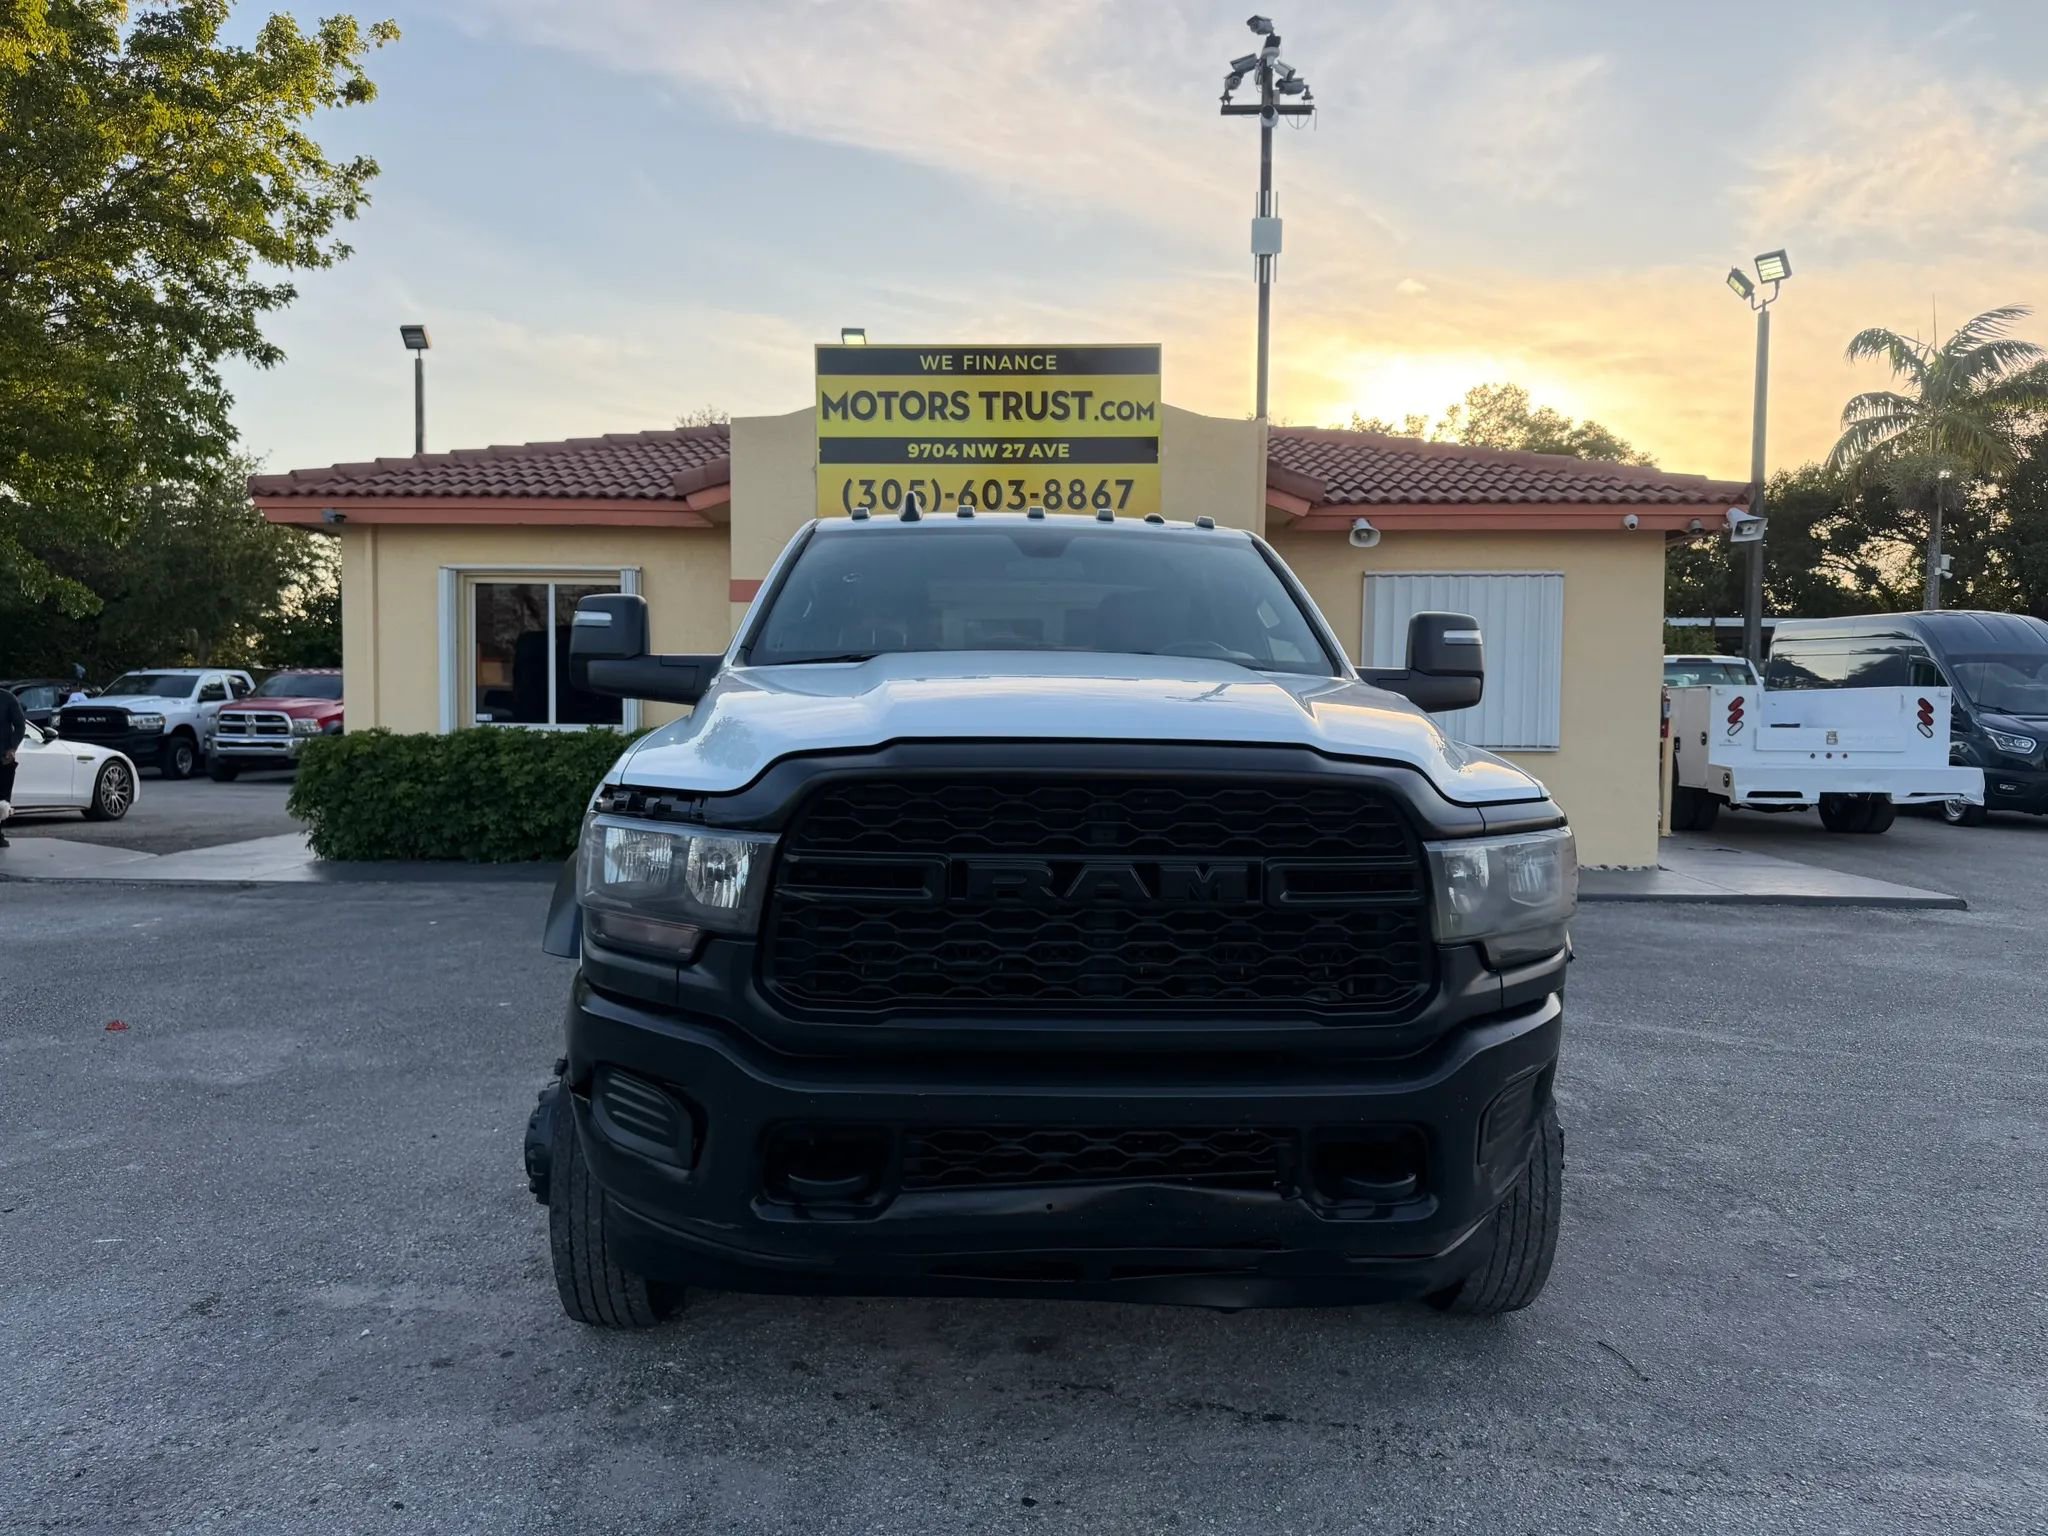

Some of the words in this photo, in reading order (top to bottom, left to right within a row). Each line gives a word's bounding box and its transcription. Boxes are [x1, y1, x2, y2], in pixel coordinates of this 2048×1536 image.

[920, 355, 953, 370] WE
[963, 354, 1057, 370] FINANCE
[822, 390, 970, 421] MOTORS
[907, 443, 959, 458] 9704
[962, 443, 999, 458] NW
[1002, 443, 1026, 458] 27
[1029, 443, 1070, 458] AVE
[966, 859, 1249, 902] RAM
